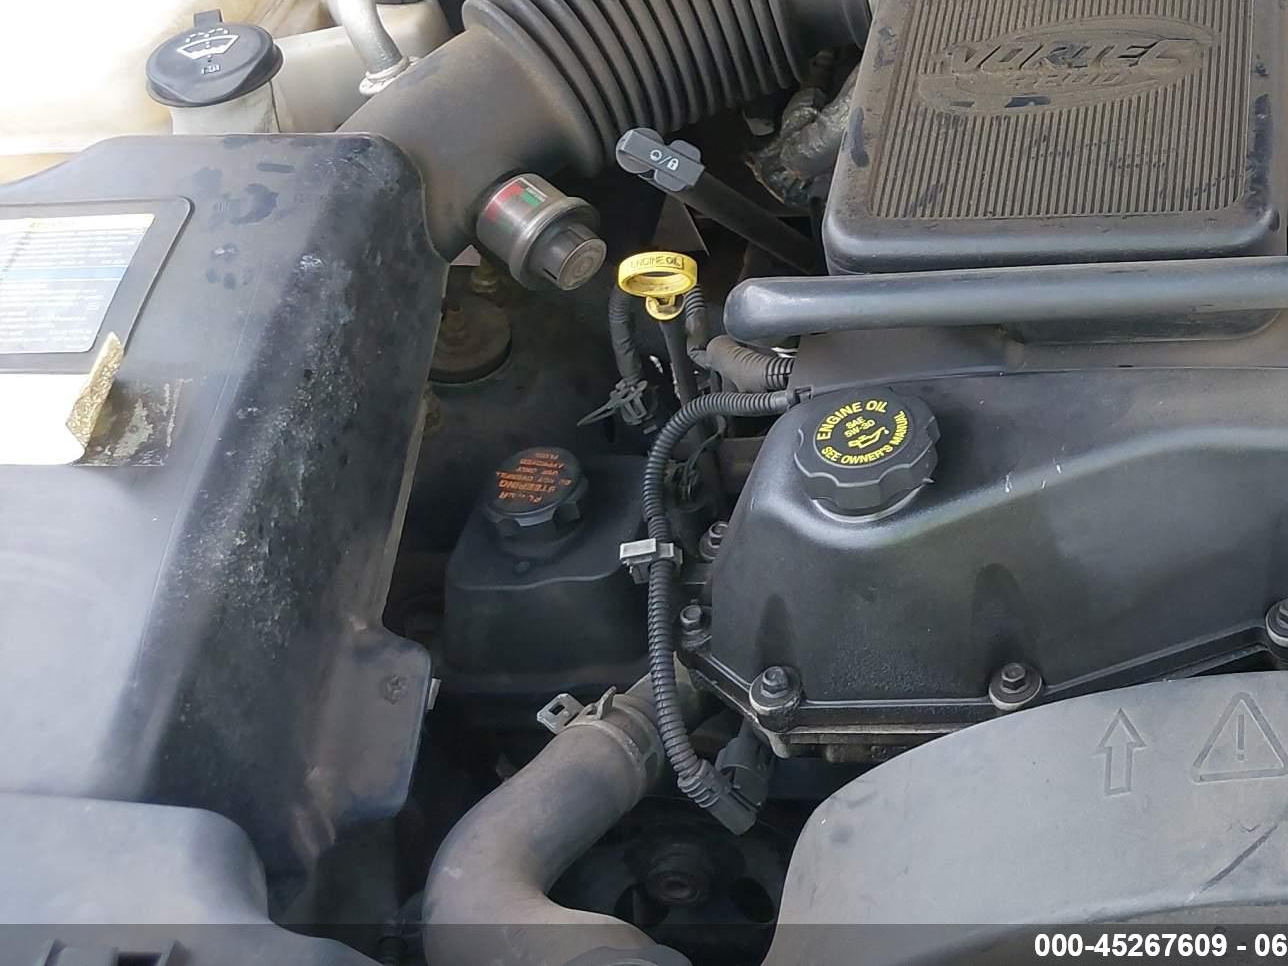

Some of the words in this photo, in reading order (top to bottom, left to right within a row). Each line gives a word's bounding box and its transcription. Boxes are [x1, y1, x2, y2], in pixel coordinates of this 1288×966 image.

[665, 256, 682, 267] OIL
[816, 401, 863, 441] ENGINE
[865, 400, 889, 413] OIL
[844, 419, 876, 438] 5W-30
[845, 416, 866, 429] SAE
[821, 446, 841, 462] SEE
[840, 445, 894, 464] OWNER'S
[889, 410, 909, 446] MANUAL
[498, 480, 557, 493] STEERING
